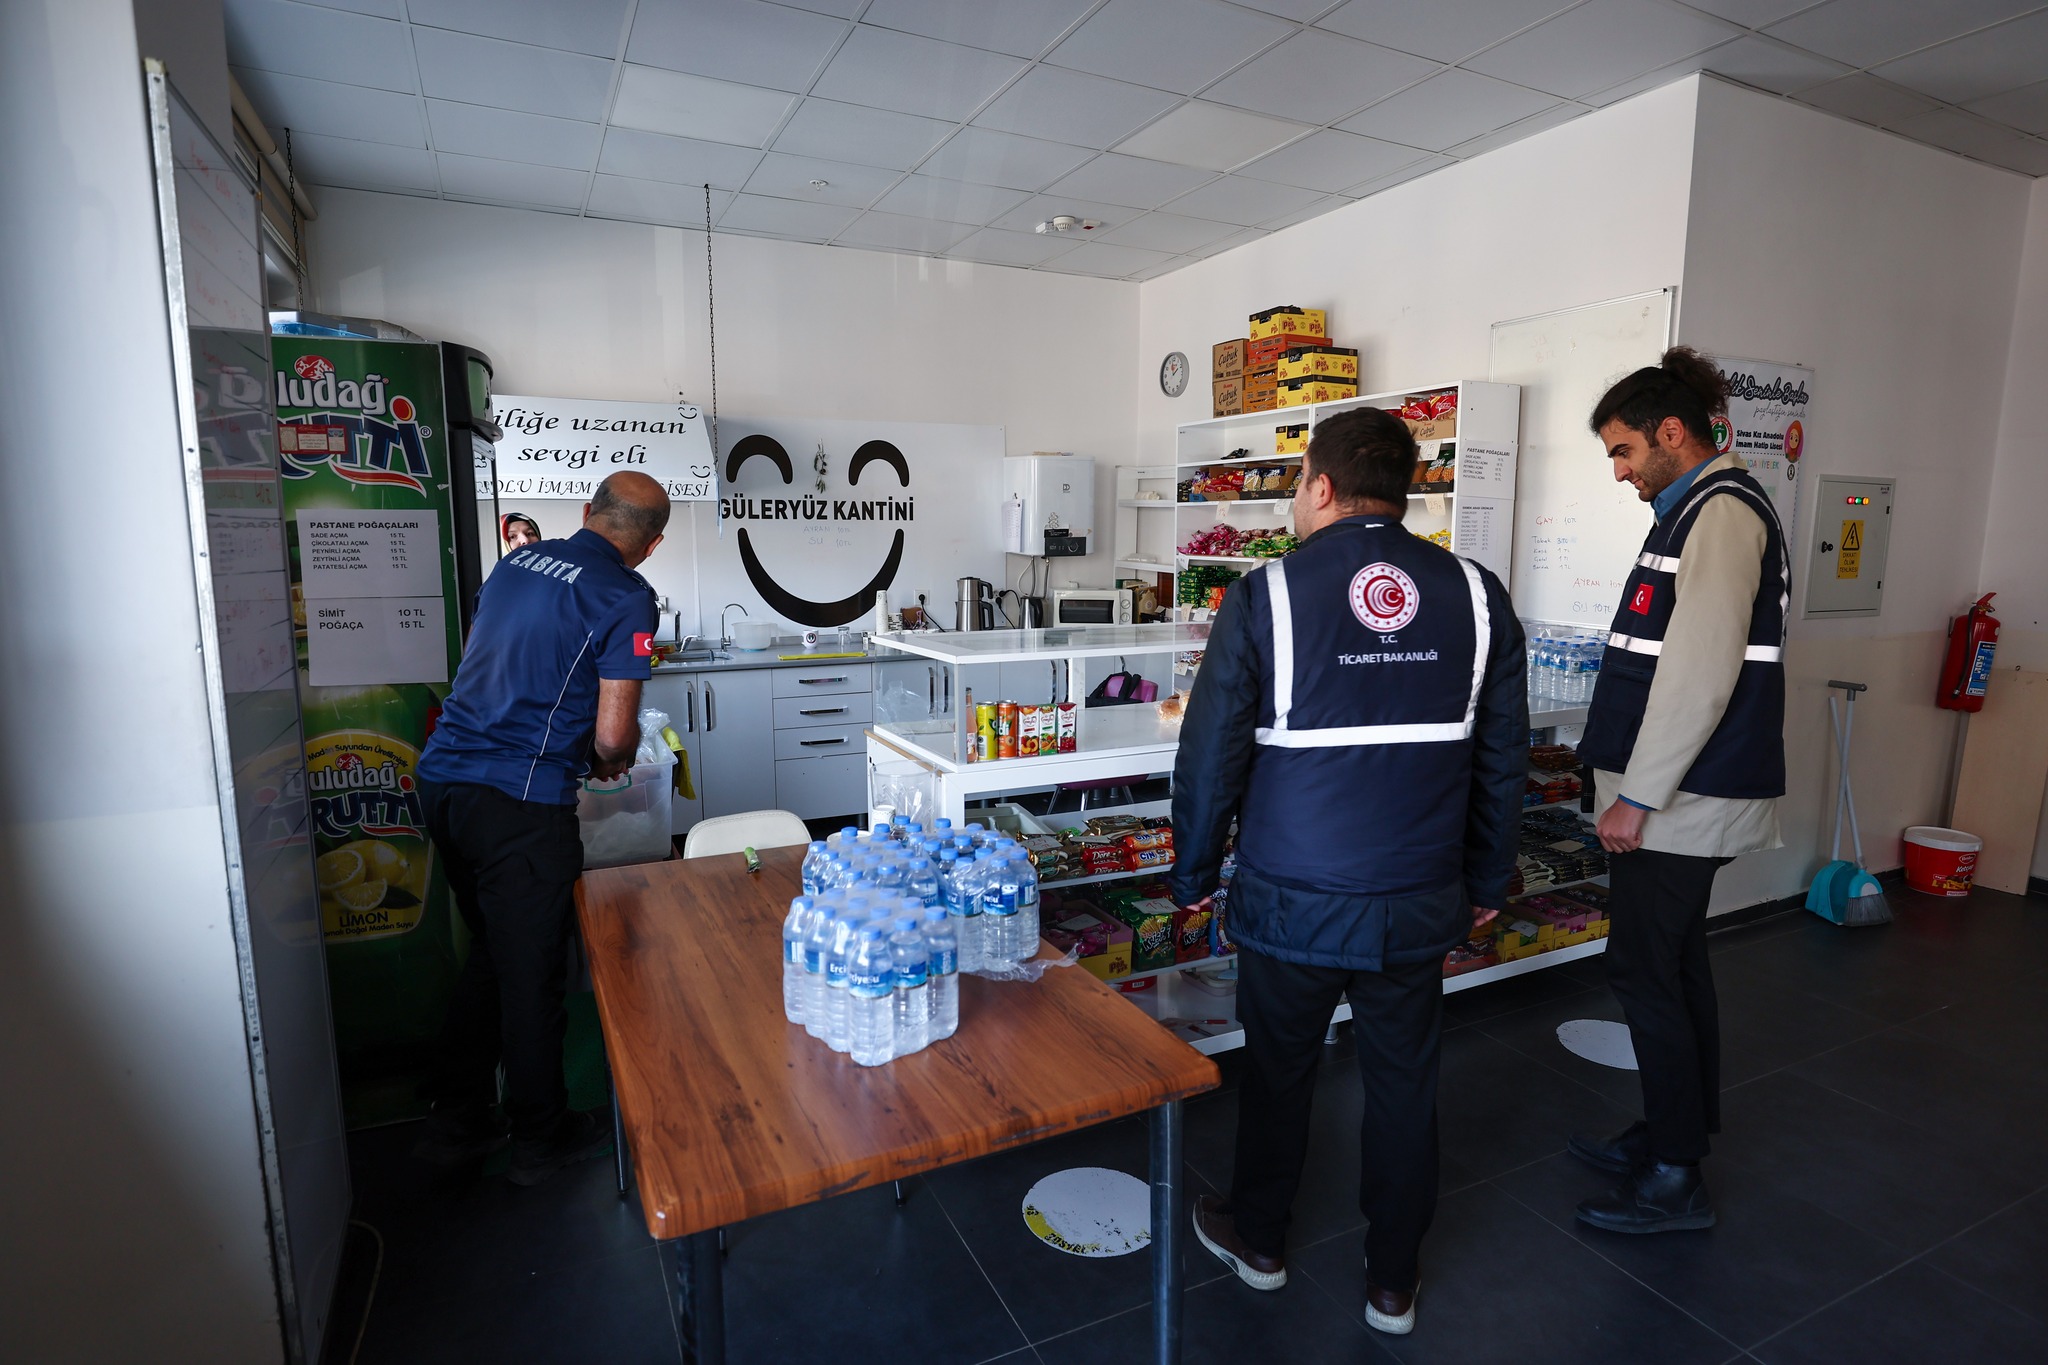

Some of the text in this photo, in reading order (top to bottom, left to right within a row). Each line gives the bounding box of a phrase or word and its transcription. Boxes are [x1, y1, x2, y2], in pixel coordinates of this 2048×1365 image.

[276, 371, 387, 415] ludağ
[571, 417, 687, 434] uzanan
[1736, 430, 1752, 438] Sivas
[1763, 432, 1784, 440] Anadolu
[1736, 439, 1752, 448] İmam
[1753, 441, 1769, 449] Hatip
[517, 444, 648, 469] sevgi eli
[537, 477, 592, 495] İMAM
[660, 479, 709, 497] İSESİ
[718, 493, 914, 521] GÜLERYÜZ KANTİNİ
[358, 521, 419, 530] POĞAÇALARI
[509, 550, 583, 584] ZABITA
[1572, 578, 1600, 588] AYRAN
[318, 608, 346, 618] SİMİT
[413, 609, 426, 617] TL
[319, 621, 425, 631] POĞAÇA 15 TL
[1379, 634, 1398, 644] T.C.
[1338, 649, 1438, 665] TİCARET BAKANLIĞI
[335, 744, 373, 752] Suyundan
[309, 762, 397, 791] uludağ
[339, 911, 388, 927] LİMON
[830, 964, 846, 974] Erci
